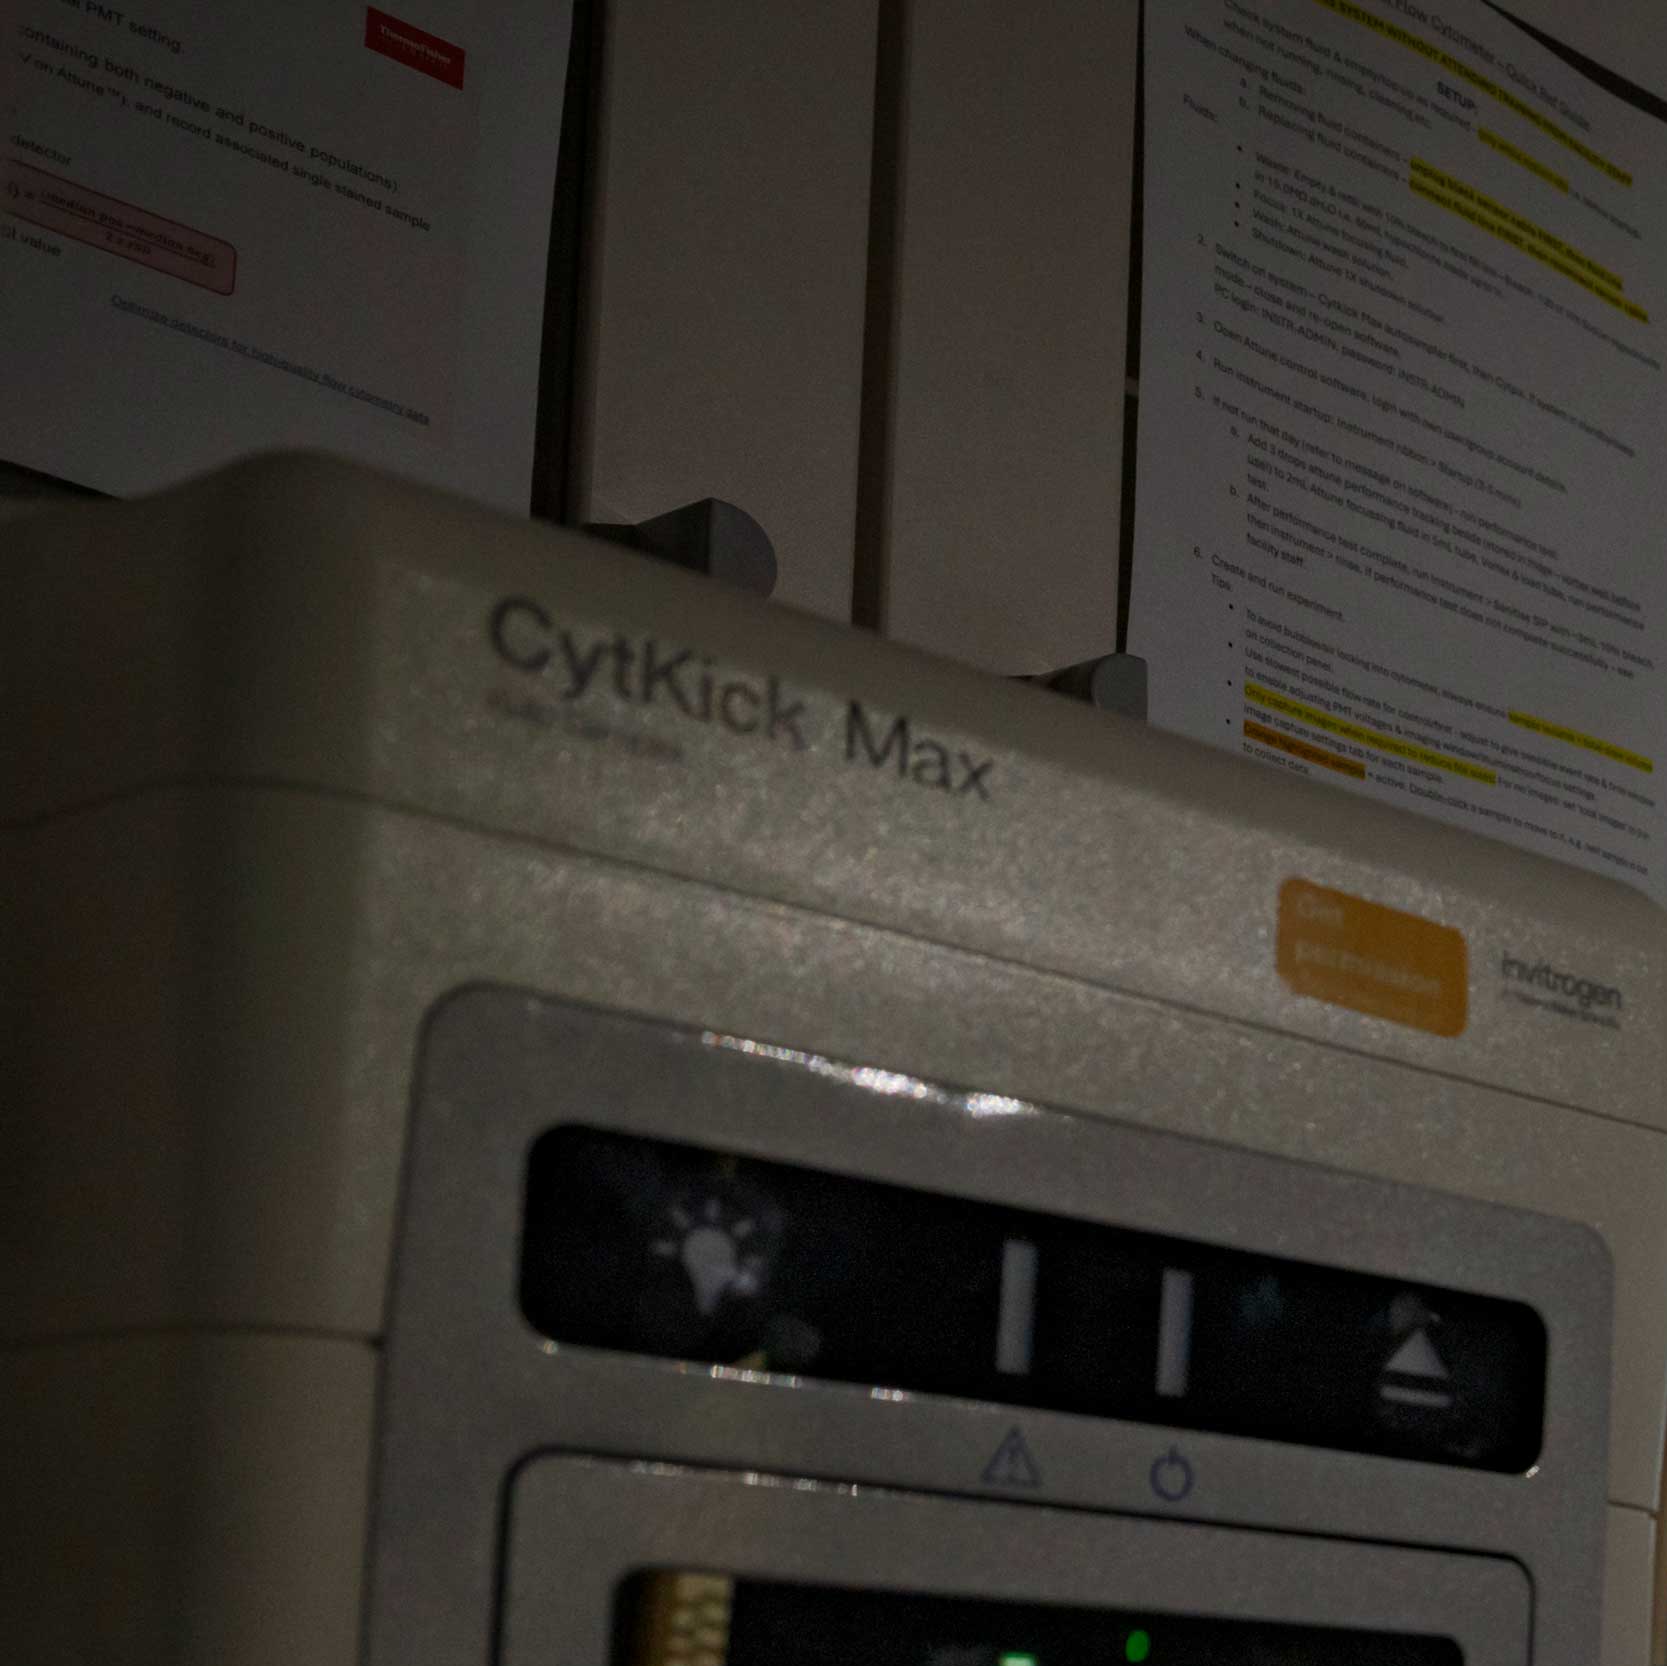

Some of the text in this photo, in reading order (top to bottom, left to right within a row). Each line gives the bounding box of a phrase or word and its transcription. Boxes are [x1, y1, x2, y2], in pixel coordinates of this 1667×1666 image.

[85, 0, 123, 27] PMT
[104, 55, 137, 84] both
[144, 72, 210, 117] negative
[215, 102, 243, 127] and
[248, 115, 304, 156] positive
[1318, 110, 1341, 132] fluid
[135, 95, 161, 120] and
[165, 107, 210, 140] record
[214, 129, 289, 173] associated
[290, 159, 331, 193] single
[334, 178, 381, 211] stained
[383, 200, 432, 237] sample
[22, 227, 61, 259] value
[1215, 240, 1306, 299] Switch on system
[1285, 295, 1305, 315] and
[1213, 355, 1233, 376] Run
[1214, 318, 1240, 346] Open
[1244, 333, 1277, 360] Attune
[1280, 351, 1317, 379] control
[1222, 397, 1238, 416] not
[1241, 410, 1256, 425] run
[1259, 416, 1278, 436] that
[1281, 427, 1299, 449] day
[1332, 449, 1342, 464] to
[1345, 458, 1389, 488] message
[1247, 430, 1409, 517] Add drops performance
[1274, 464, 1283, 479] to
[1310, 480, 1343, 505] Attune
[1397, 517, 1418, 537] fluid
[1246, 491, 1356, 551] After performance test
[1212, 552, 1283, 595] Create and run
[1247, 510, 1269, 531] then
[1374, 567, 1437, 607] performance
[1245, 644, 1262, 662] Use
[1246, 628, 1257, 641] on
[487, 593, 808, 752] CytKick
[845, 701, 995, 802] Max
[1245, 682, 1264, 704] Only
[1268, 692, 1302, 720] capture
[1305, 707, 1337, 733] images
[1340, 720, 1364, 739] when
[1289, 681, 1330, 711] adjusting
[1274, 712, 1308, 740] capture
[1366, 747, 1378, 762] for
[1502, 950, 1623, 1012] invitrogen
